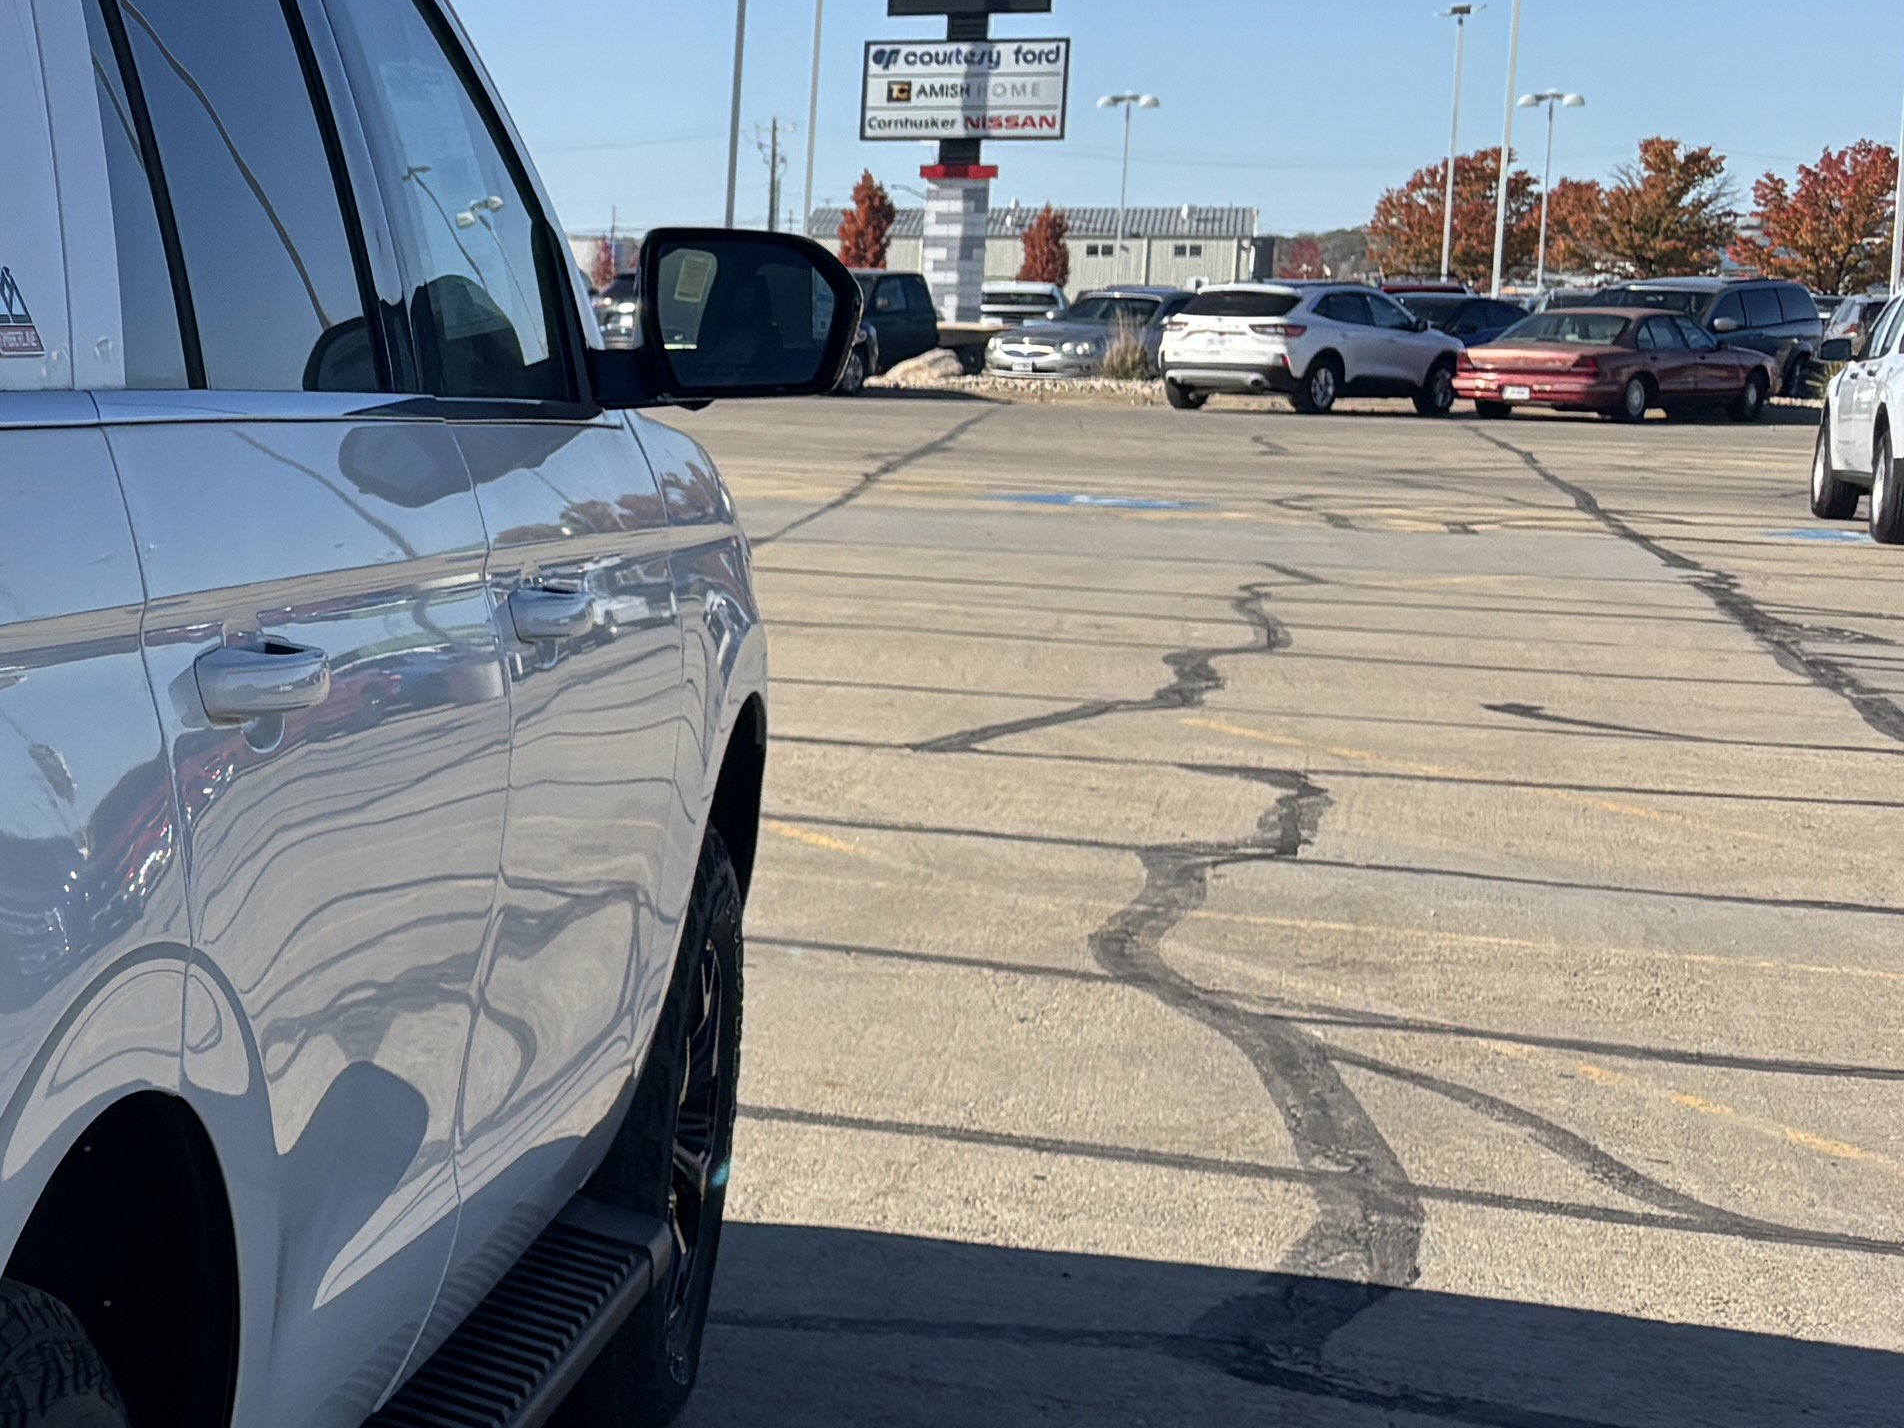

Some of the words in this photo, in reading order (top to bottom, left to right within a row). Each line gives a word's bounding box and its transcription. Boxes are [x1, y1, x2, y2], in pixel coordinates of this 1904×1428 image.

[903, 46, 1002, 70] courtesy
[1014, 44, 1061, 66] ford
[916, 81, 970, 99] AMISH
[867, 116, 957, 132] Cornhusker
[963, 114, 1057, 131] NISSAN
